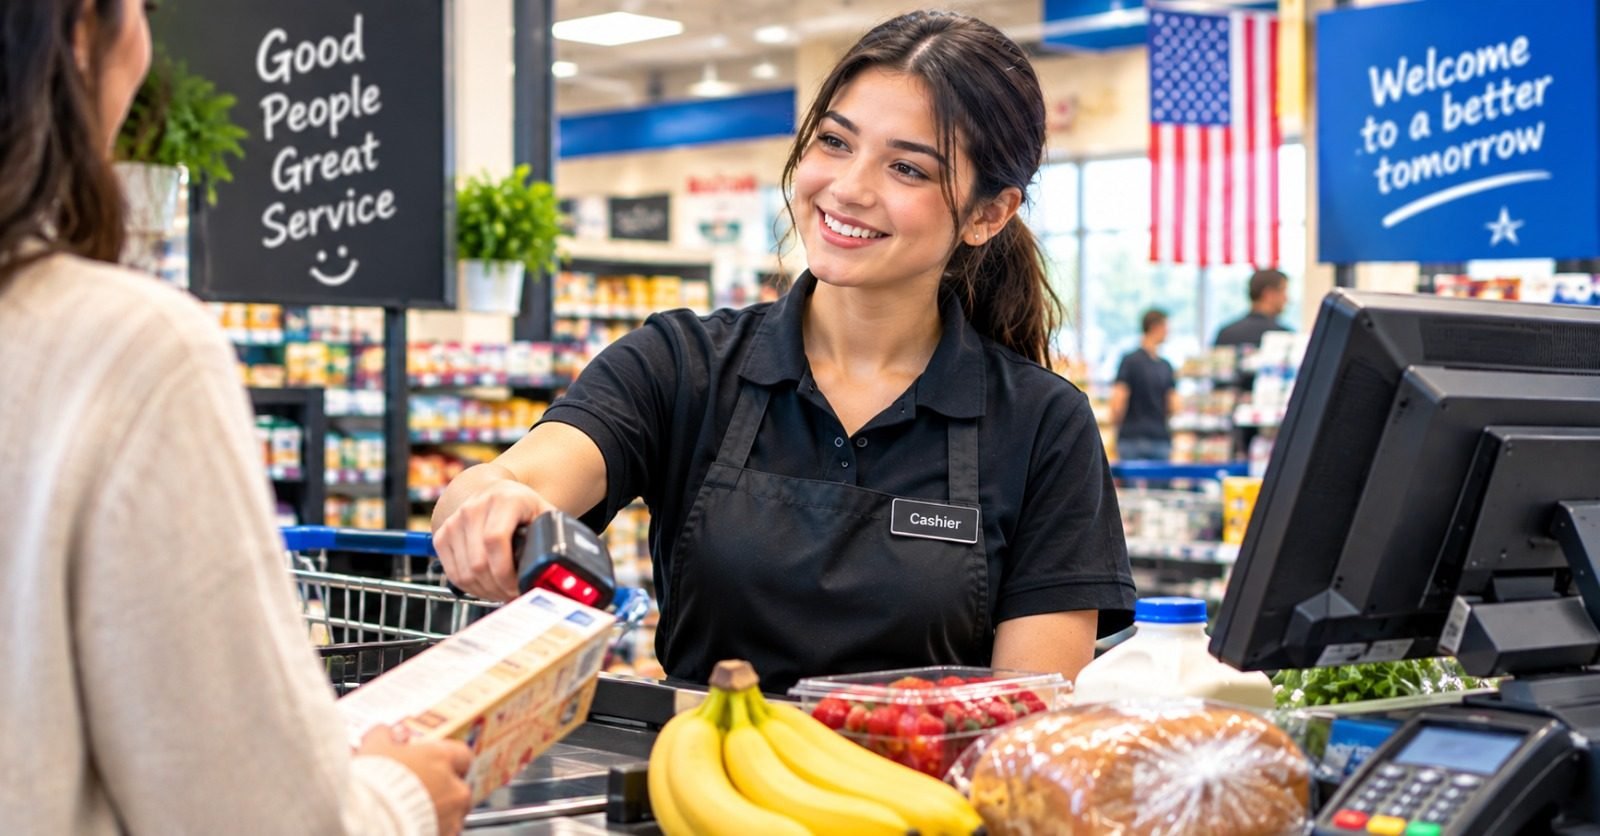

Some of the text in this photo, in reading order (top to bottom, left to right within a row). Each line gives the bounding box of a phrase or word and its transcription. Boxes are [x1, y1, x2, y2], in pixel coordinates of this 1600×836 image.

[256, 14, 365, 84] Good
[1369, 35, 1531, 107] Welcome
[260, 75, 382, 141] People
[1361, 75, 1553, 153] to a better
[271, 132, 380, 193] Great
[1374, 122, 1545, 194] tomorrow
[262, 188, 396, 248] Service
[910, 512, 962, 529] Cashier
